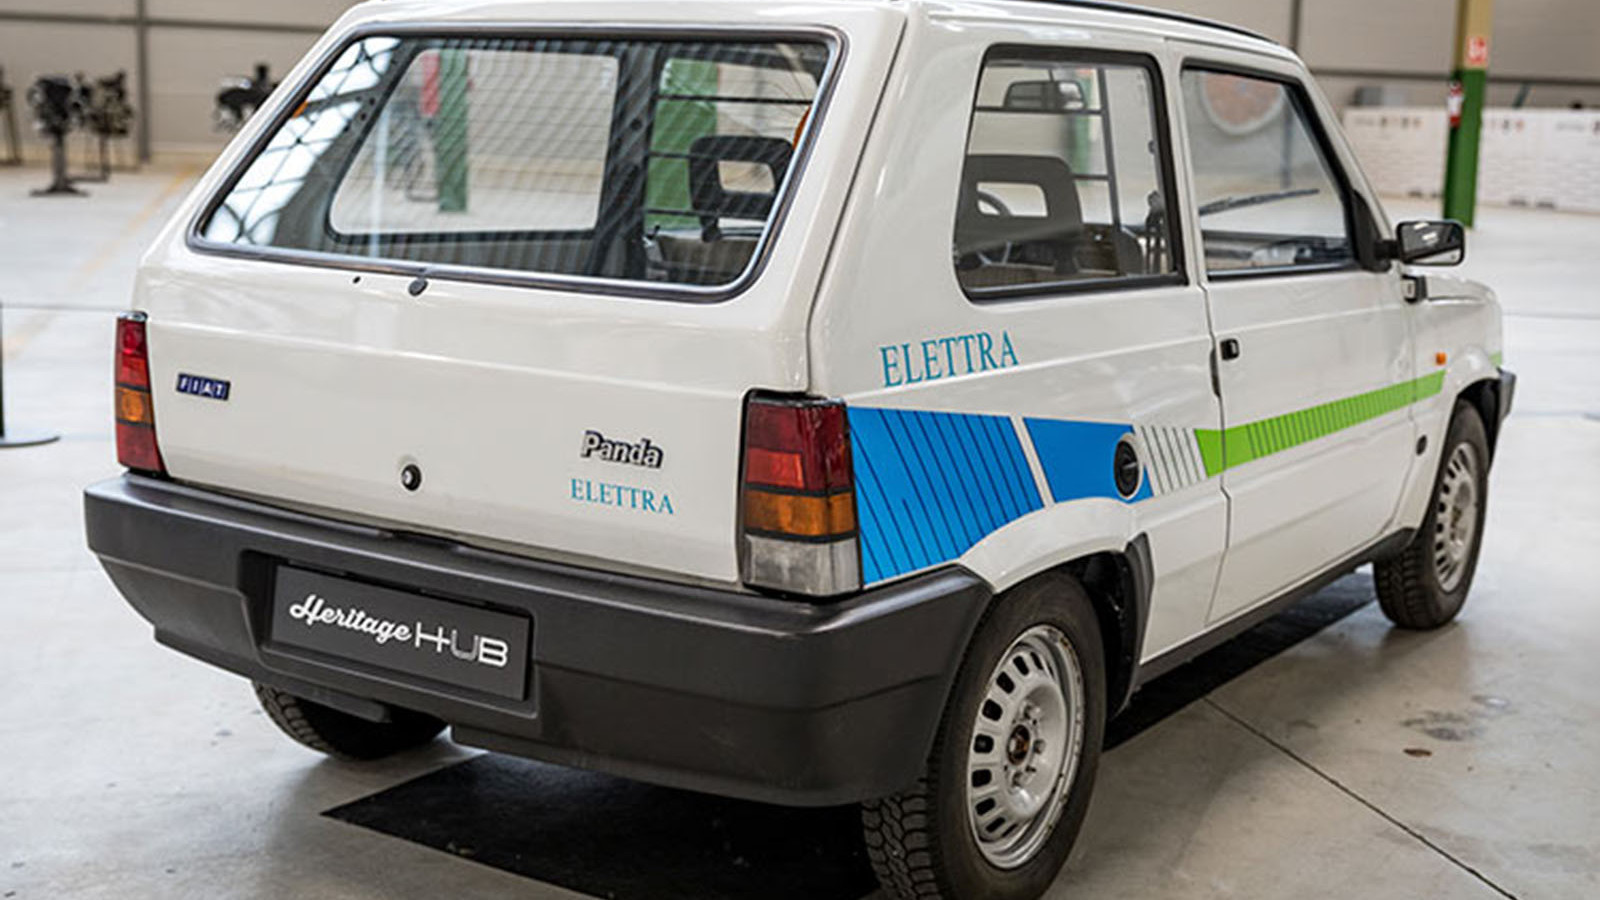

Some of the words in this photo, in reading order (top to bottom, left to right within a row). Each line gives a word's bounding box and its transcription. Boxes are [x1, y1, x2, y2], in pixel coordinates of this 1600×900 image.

[879, 330, 1019, 388] ELETTRA
[178, 375, 227, 398] FIAT
[580, 430, 664, 469] Panda
[570, 478, 674, 515] ELETTRA
[289, 594, 412, 645] Heritage
[414, 621, 509, 667] HUB
